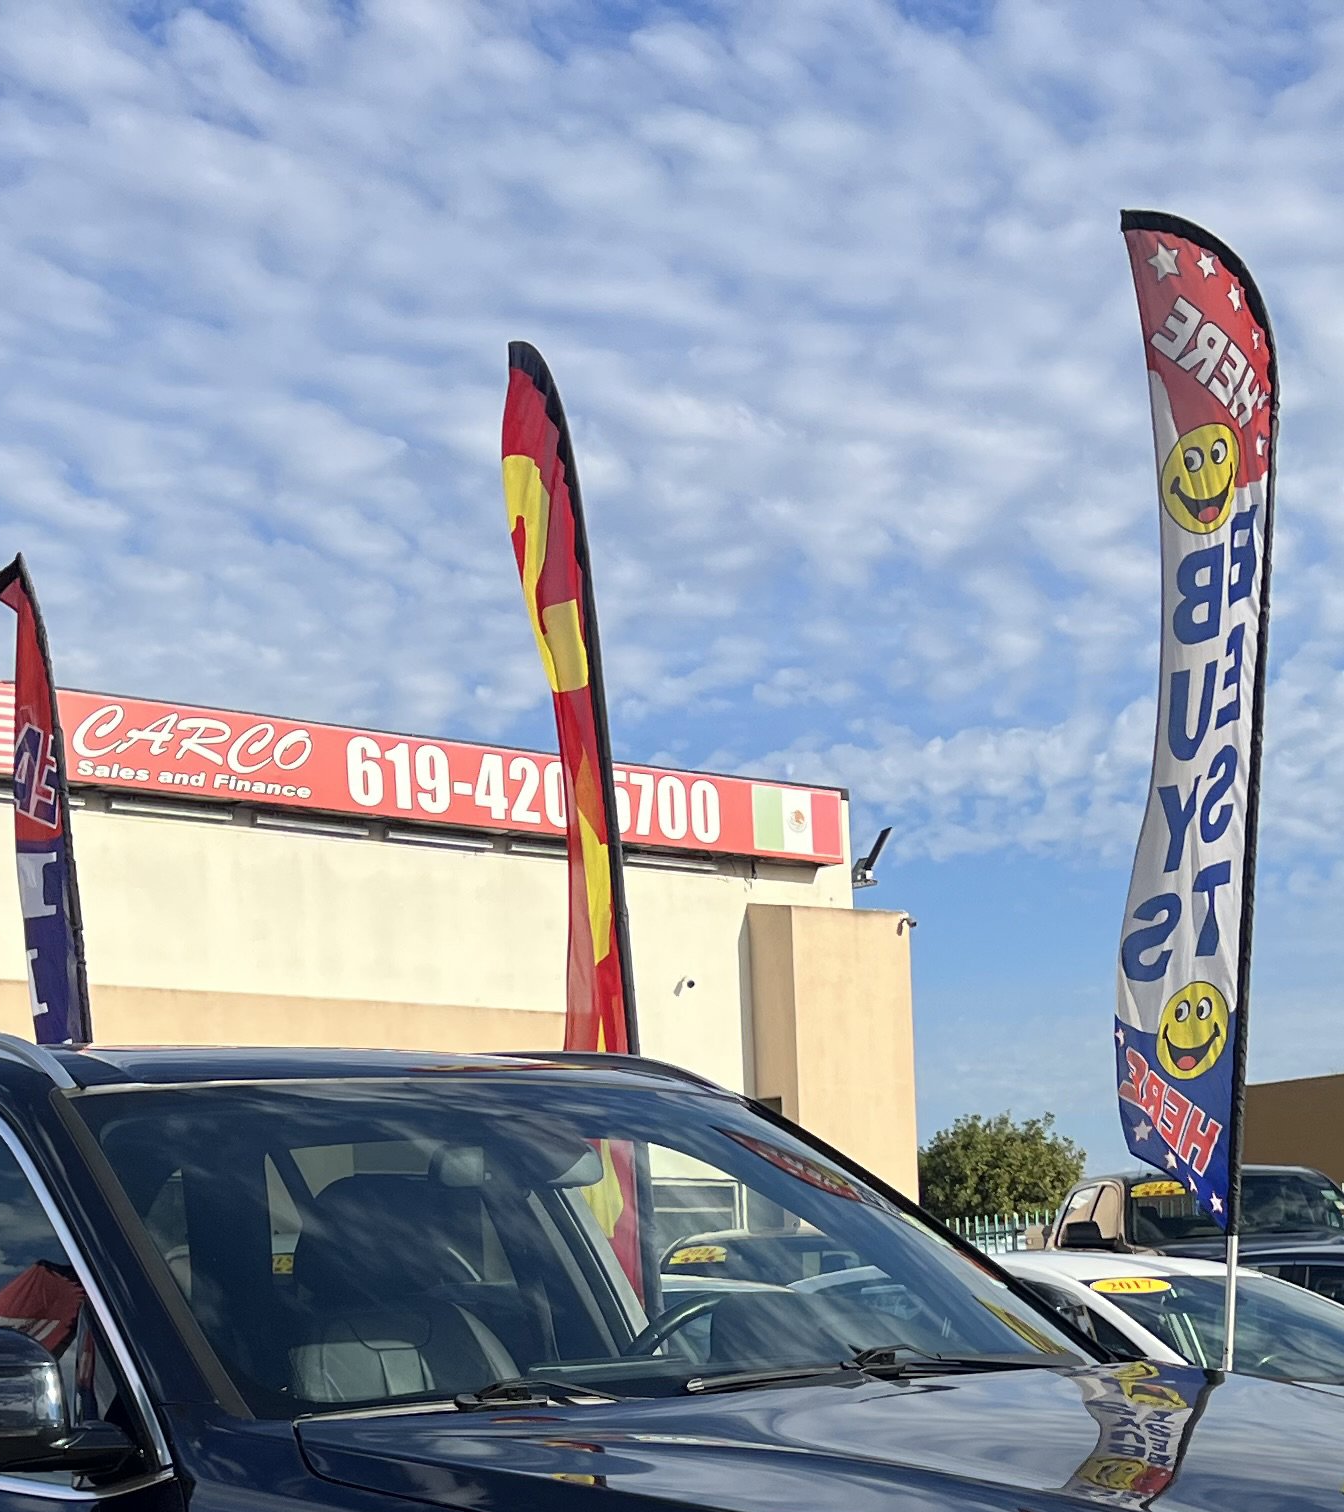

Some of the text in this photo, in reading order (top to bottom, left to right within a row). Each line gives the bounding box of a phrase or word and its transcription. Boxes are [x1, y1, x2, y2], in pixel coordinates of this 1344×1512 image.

[72, 704, 313, 774] CARCO
[77, 759, 312, 799] Sales and Finance
[346, 735, 721, 844] 619-4205700
[1107, 1280, 1152, 1291] 2017
